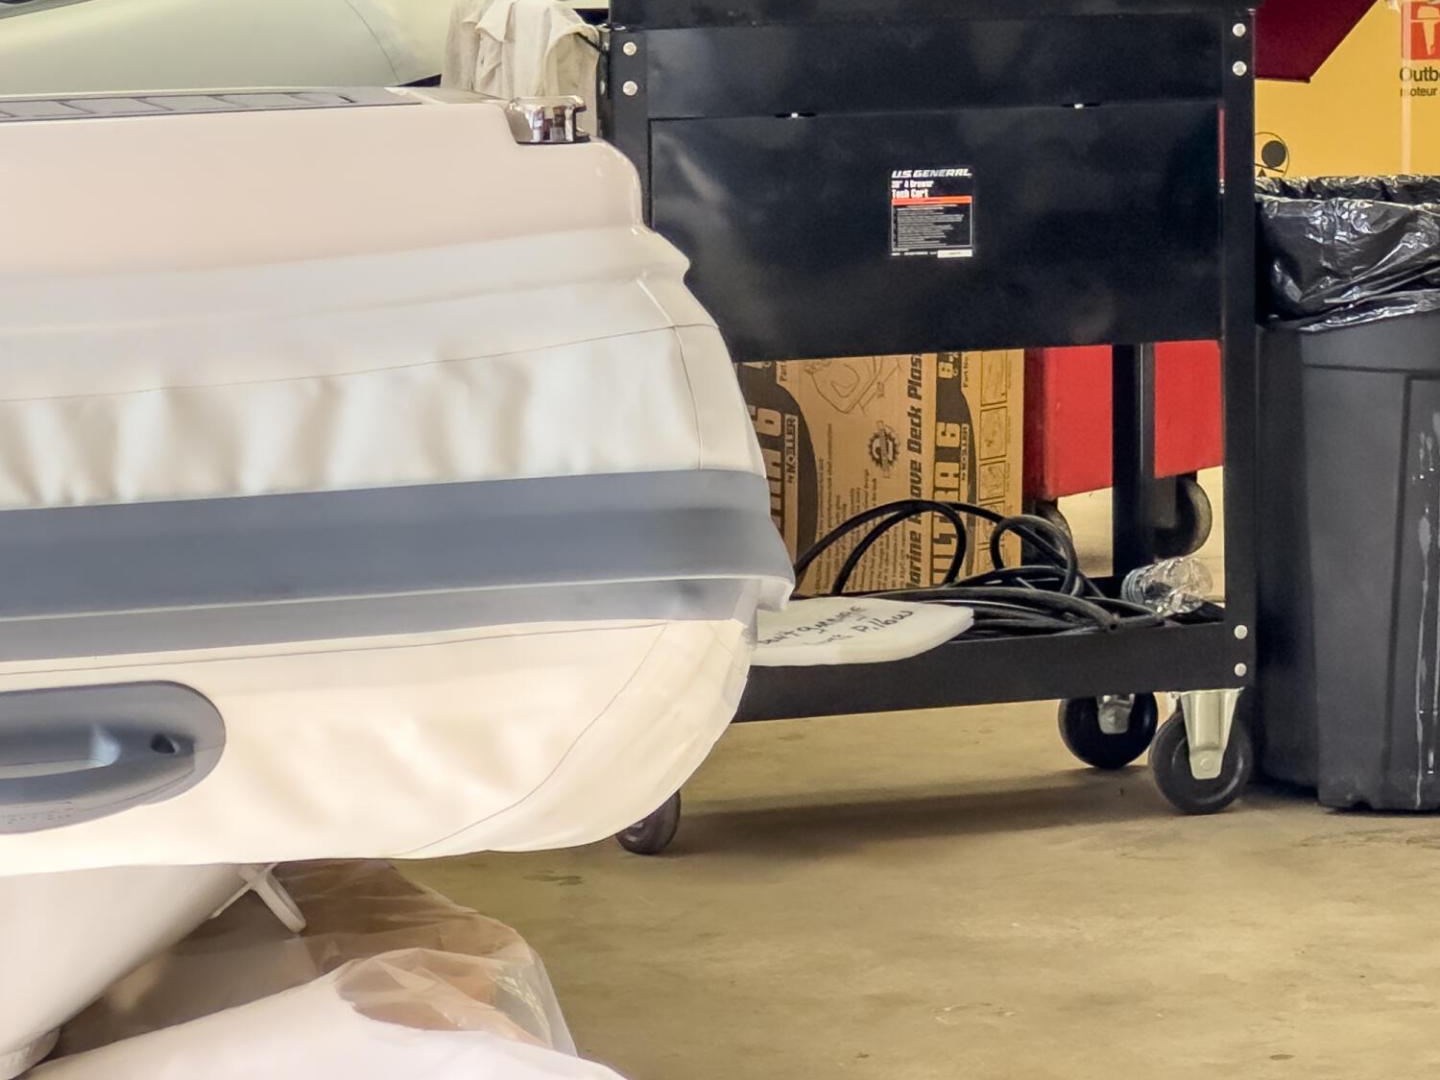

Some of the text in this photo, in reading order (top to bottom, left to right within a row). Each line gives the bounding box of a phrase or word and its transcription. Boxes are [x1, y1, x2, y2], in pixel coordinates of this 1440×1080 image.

[906, 353, 922, 401] Plas
[906, 404, 922, 454] Deck
[906, 460, 922, 524] Aove
